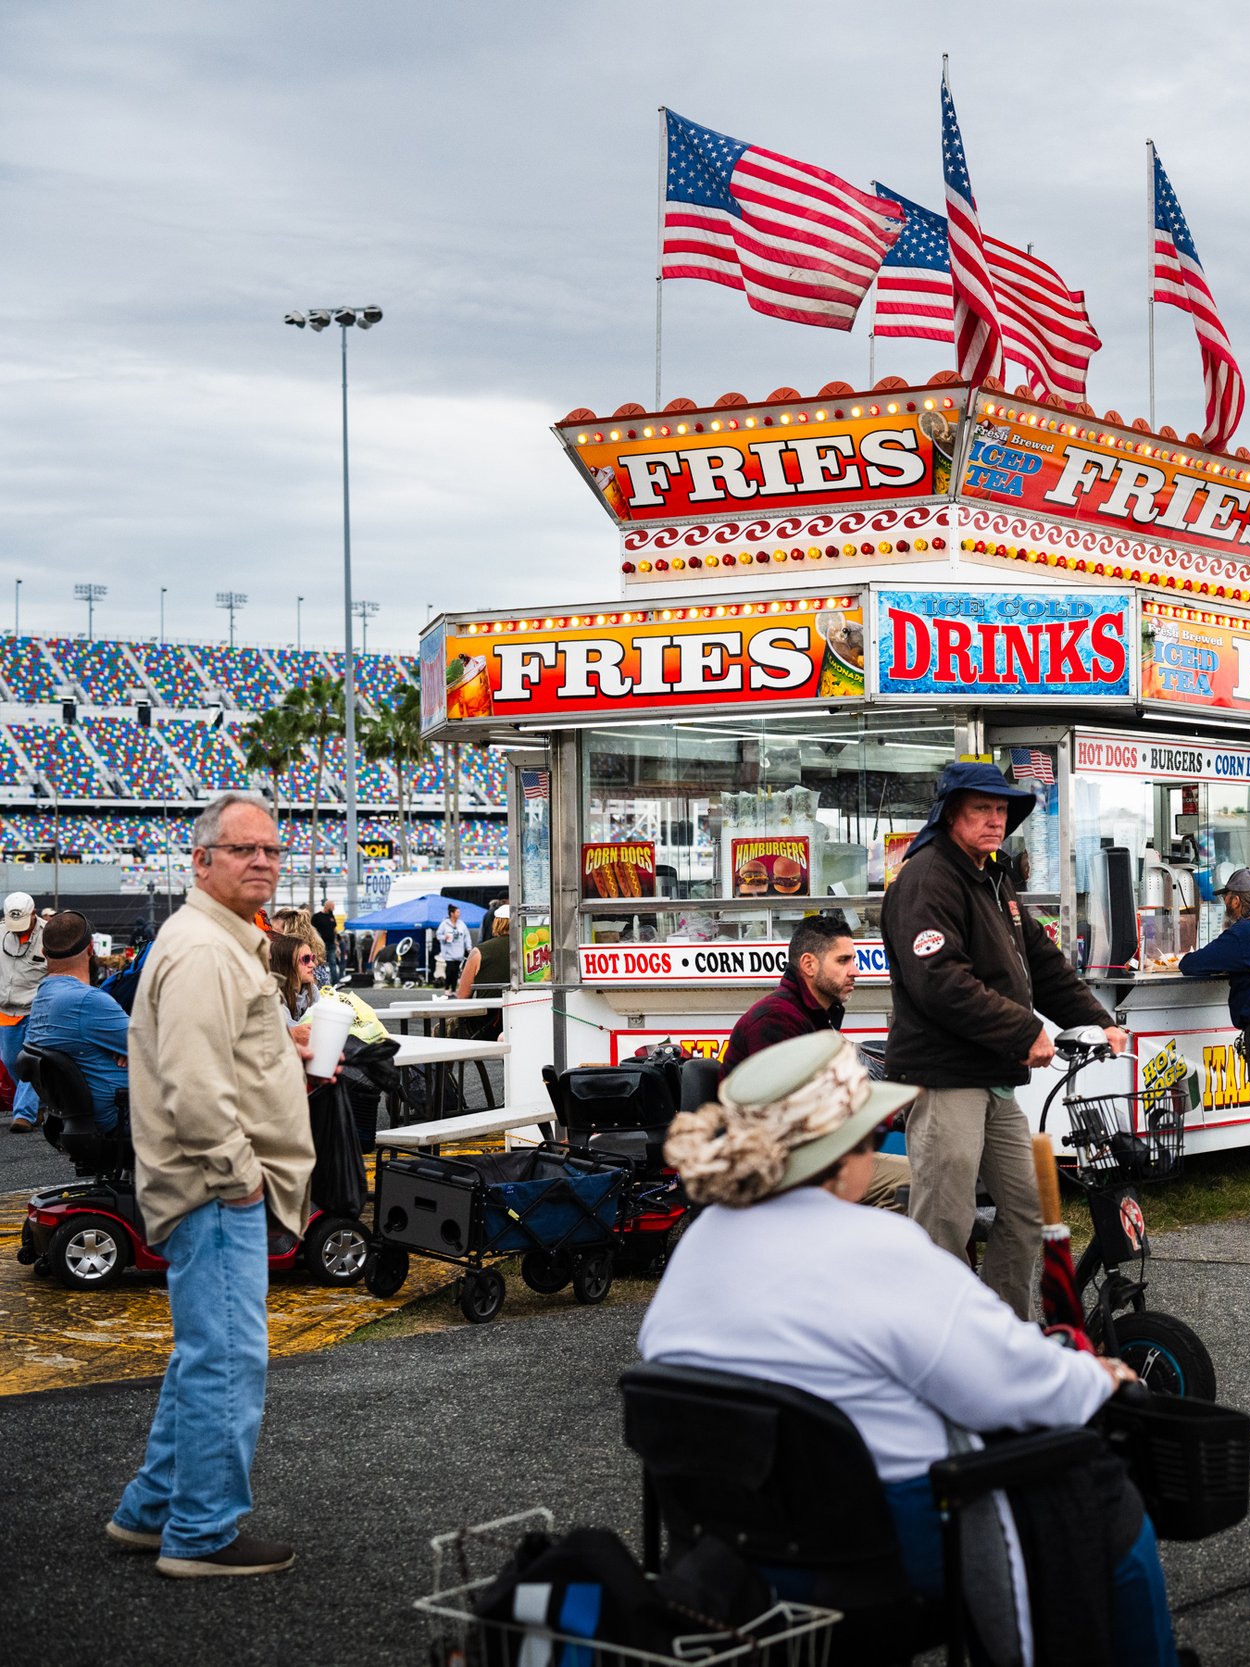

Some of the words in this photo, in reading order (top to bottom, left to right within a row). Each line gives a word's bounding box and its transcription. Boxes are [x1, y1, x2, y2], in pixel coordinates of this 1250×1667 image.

[975, 425, 1008, 441] Fresh
[1011, 434, 1054, 452] Brewed
[618, 428, 925, 507] FRIES
[969, 440, 1043, 475] ICED
[966, 464, 1023, 497] TEA
[922, 598, 985, 616] ICE
[996, 599, 1093, 617] COLD
[888, 607, 1126, 684] DRINKS
[1148, 623, 1179, 637] Fresh
[1182, 630, 1223, 646] Brewed
[493, 627, 813, 700] FRIES
[827, 653, 864, 683] LEMONADE
[1153, 640, 1219, 672] ICED
[1159, 667, 1214, 697] TEA
[1078, 742, 1103, 765] HOT
[1105, 745, 1137, 768] DOGS
[1150, 748, 1203, 773] BURGERS
[1215, 754, 1244, 776] CORN
[585, 847, 617, 875] CORN
[621, 845, 653, 874] DOGS
[735, 841, 807, 872] HAMBURGERS
[366, 875, 391, 894] FOOD
[584, 953, 620, 974] HOT
[624, 953, 672, 974] DOGS
[695, 952, 744, 973] CORN
[750, 951, 788, 973] DOG
[1142, 1038, 1176, 1088] HOT
[1142, 1054, 1187, 1115] DOGS
